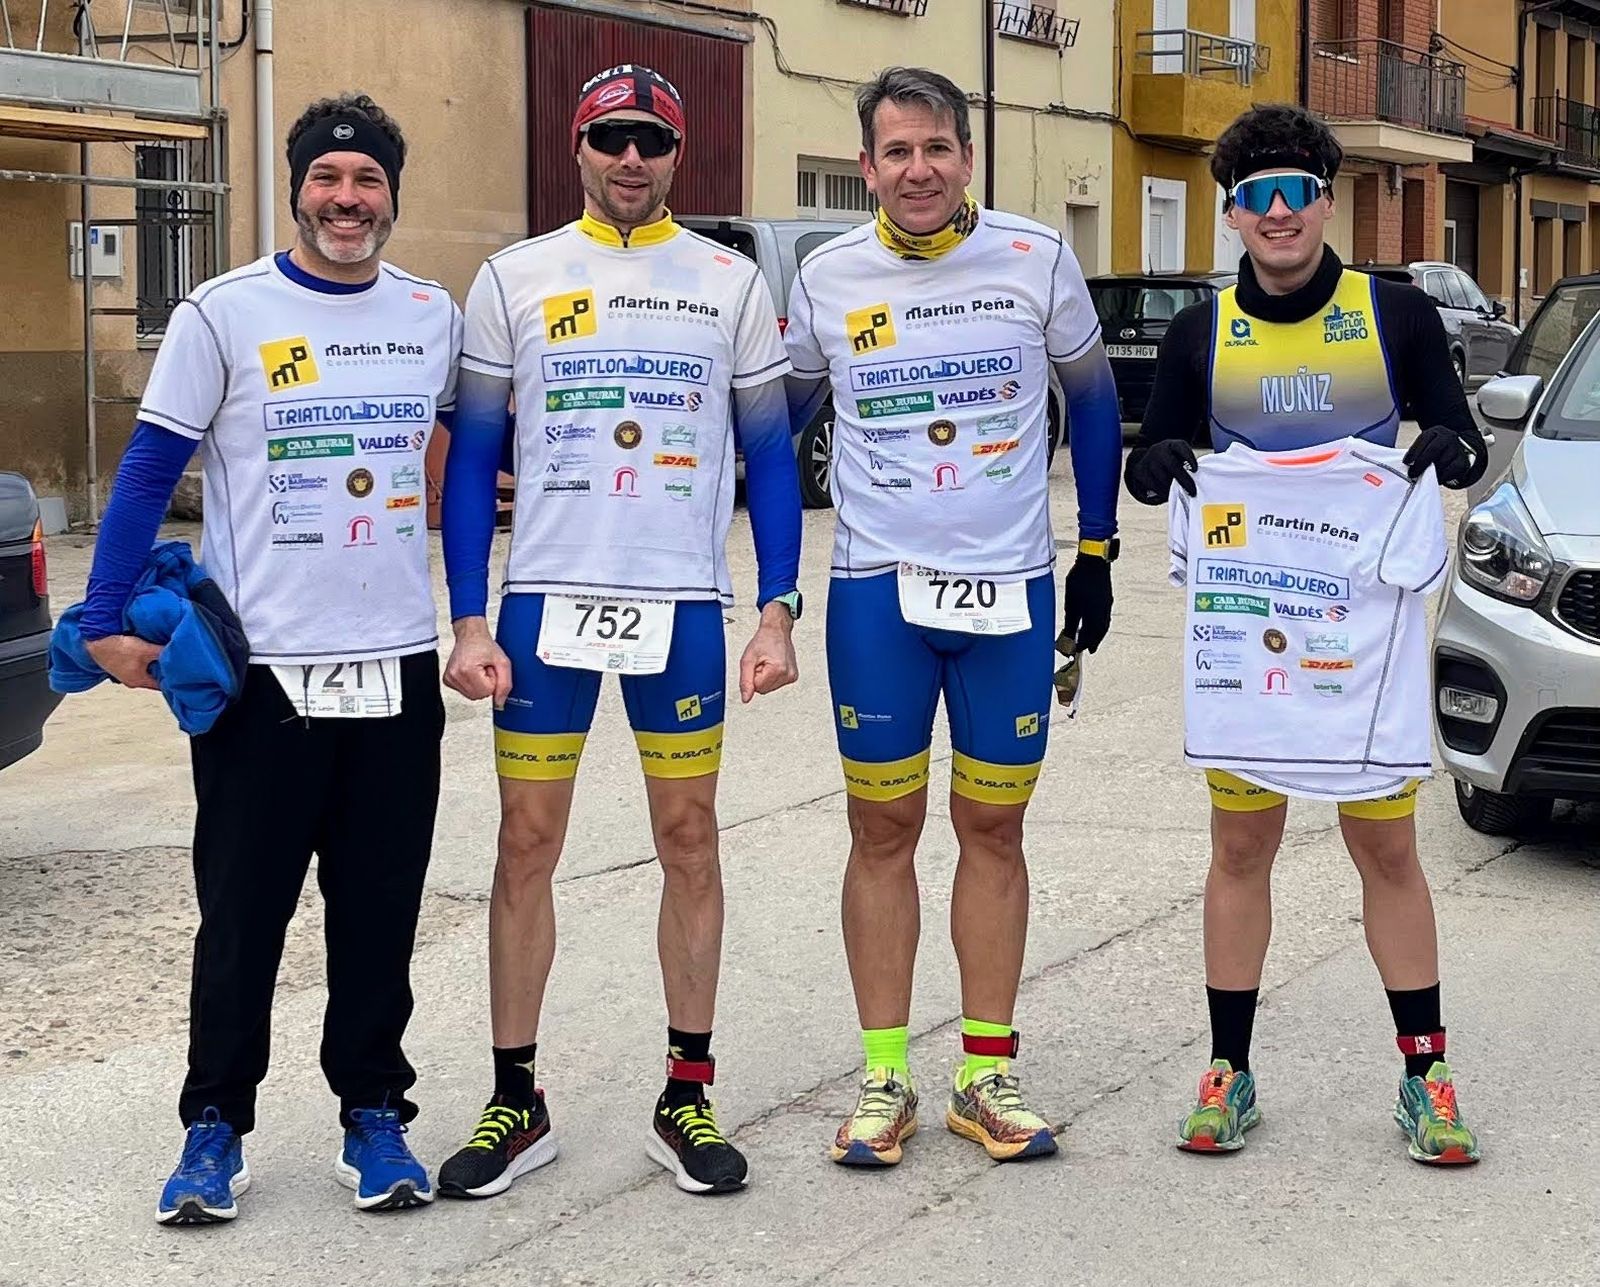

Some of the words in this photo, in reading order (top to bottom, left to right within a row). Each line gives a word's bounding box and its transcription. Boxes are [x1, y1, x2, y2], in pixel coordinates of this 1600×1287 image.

[677, 300, 719, 317] Peña
[972, 297, 1015, 312] Peña
[1325, 327, 1368, 343] DUERO
[386, 342, 424, 355] Peña
[1136, 347, 1155, 357] HGV
[642, 358, 703, 379] DUERO
[948, 356, 1013, 377] DUERO
[937, 387, 996, 406] VALDÉS
[1262, 366, 1334, 413] MUÑIZ
[629, 391, 685, 407] VALDÉS
[368, 403, 425, 419] DUERO
[358, 434, 409, 450] VALDÉS
[1321, 523, 1360, 543] Peña
[929, 579, 996, 609] 720
[1285, 575, 1339, 597] DUERO
[1274, 602, 1323, 619] VALDÉS
[575, 603, 641, 640] 752
